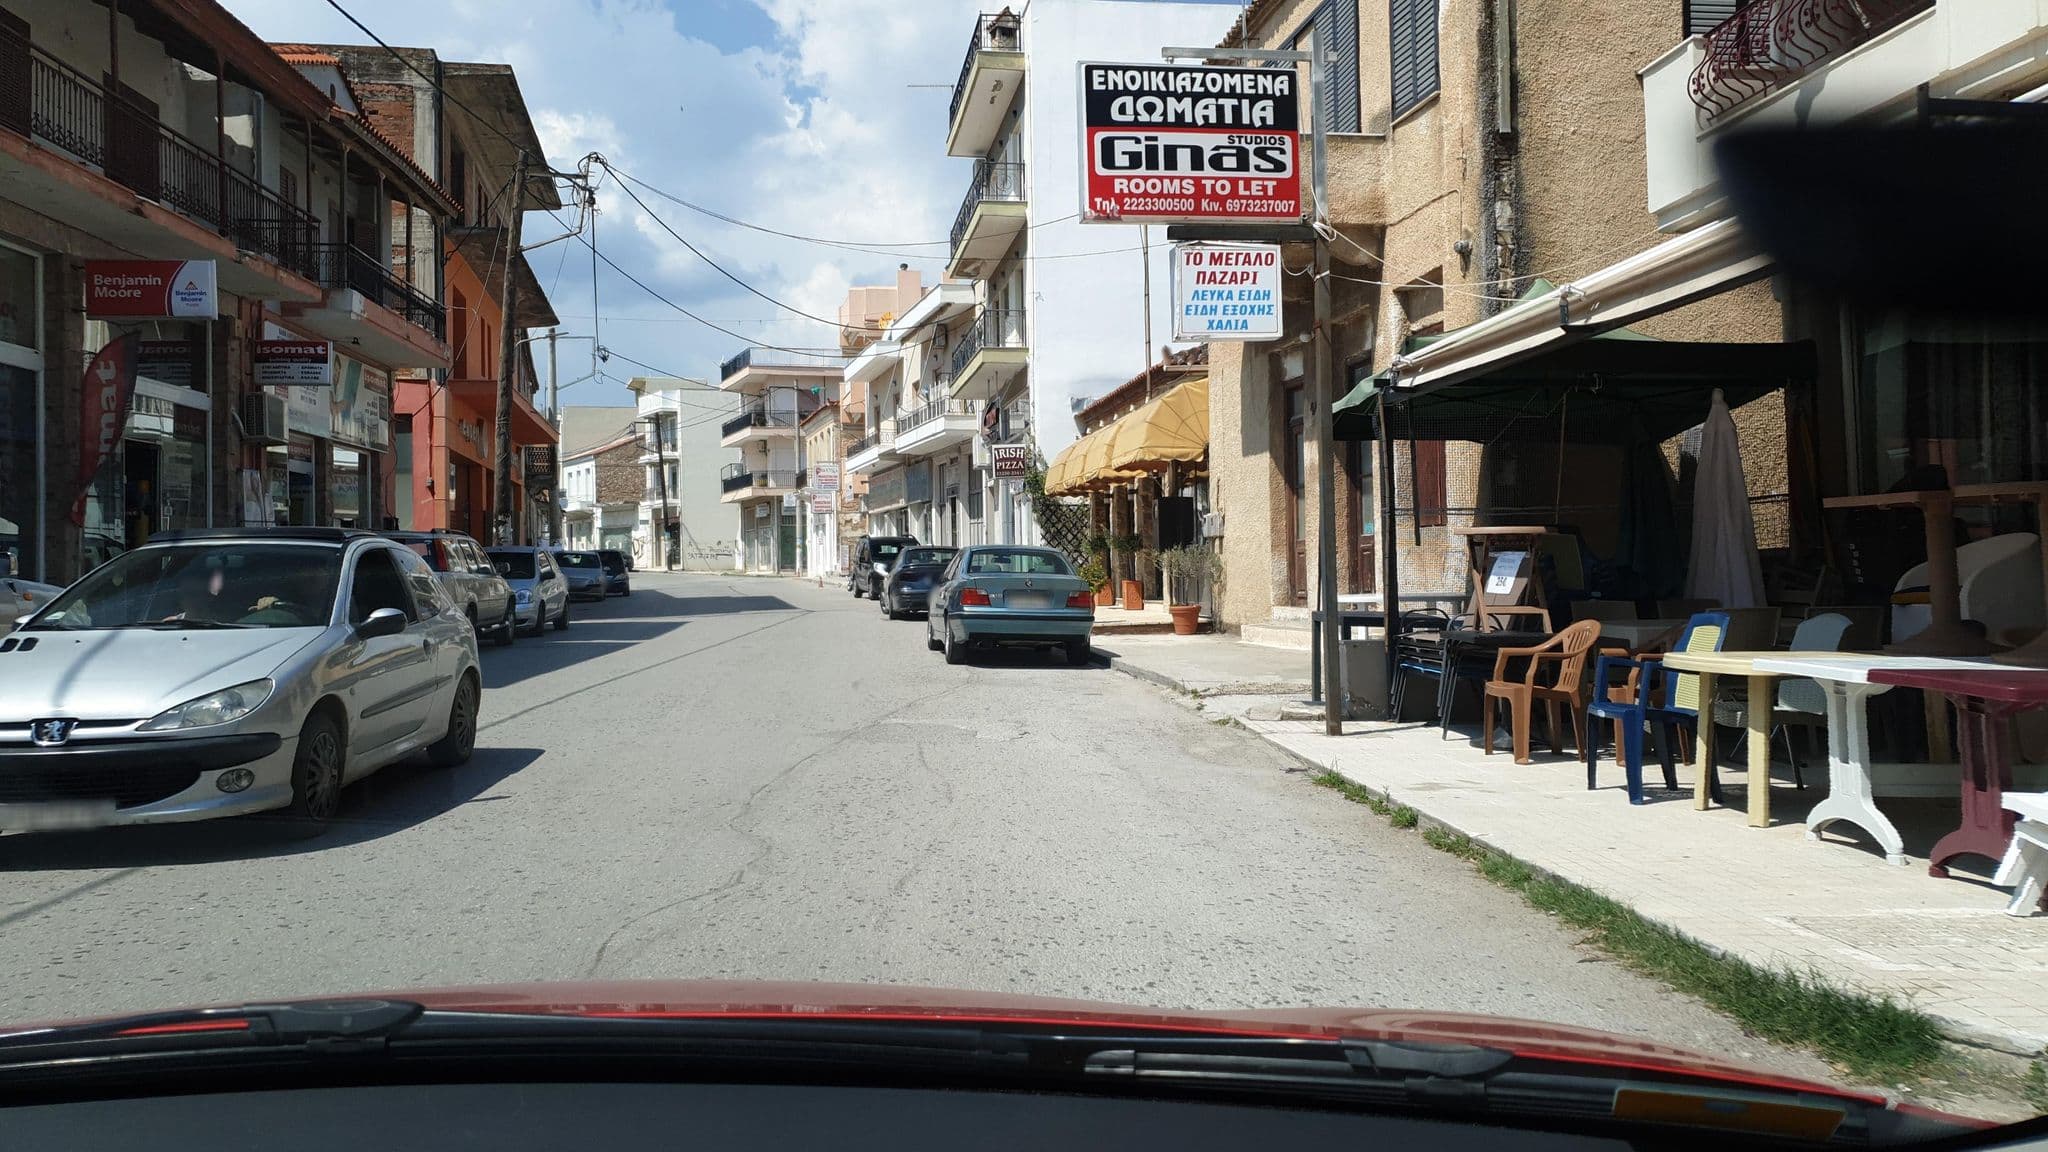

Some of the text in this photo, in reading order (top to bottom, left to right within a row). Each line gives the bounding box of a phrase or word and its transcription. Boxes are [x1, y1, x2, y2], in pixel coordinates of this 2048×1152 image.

[1092, 70, 1289, 97] ΕΝΟΙΚΙΑΖΟΜΕΝΑ
[1110, 95, 1275, 127] ΔΩΜΑΤΙΑ
[1227, 134, 1286, 146] STUDIOS
[1100, 135, 1287, 173] Ginas
[1114, 178, 1277, 197] ROOMS TO LET
[1123, 198, 1194, 211] 2223300500
[1226, 199, 1295, 213] 6973237007
[1184, 252, 1275, 266] ΤΟ ΜΕΓΑΛΟ
[94, 274, 162, 288] Benjamin
[1196, 271, 1259, 285] ΠΑΖΑΡΙ
[95, 287, 142, 298] Moore
[175, 290, 207, 298] Benjamin
[1191, 289, 1271, 301] ΛΕΥΚΑ ΕΙΔΗ
[1184, 304, 1275, 316] ΕΙΔΗ ΕΞΟΧΗΣ
[1206, 319, 1249, 331] ΧΑΛΙΑ
[995, 448, 1025, 459] IRISH
[996, 461, 1025, 470] PIZZA
